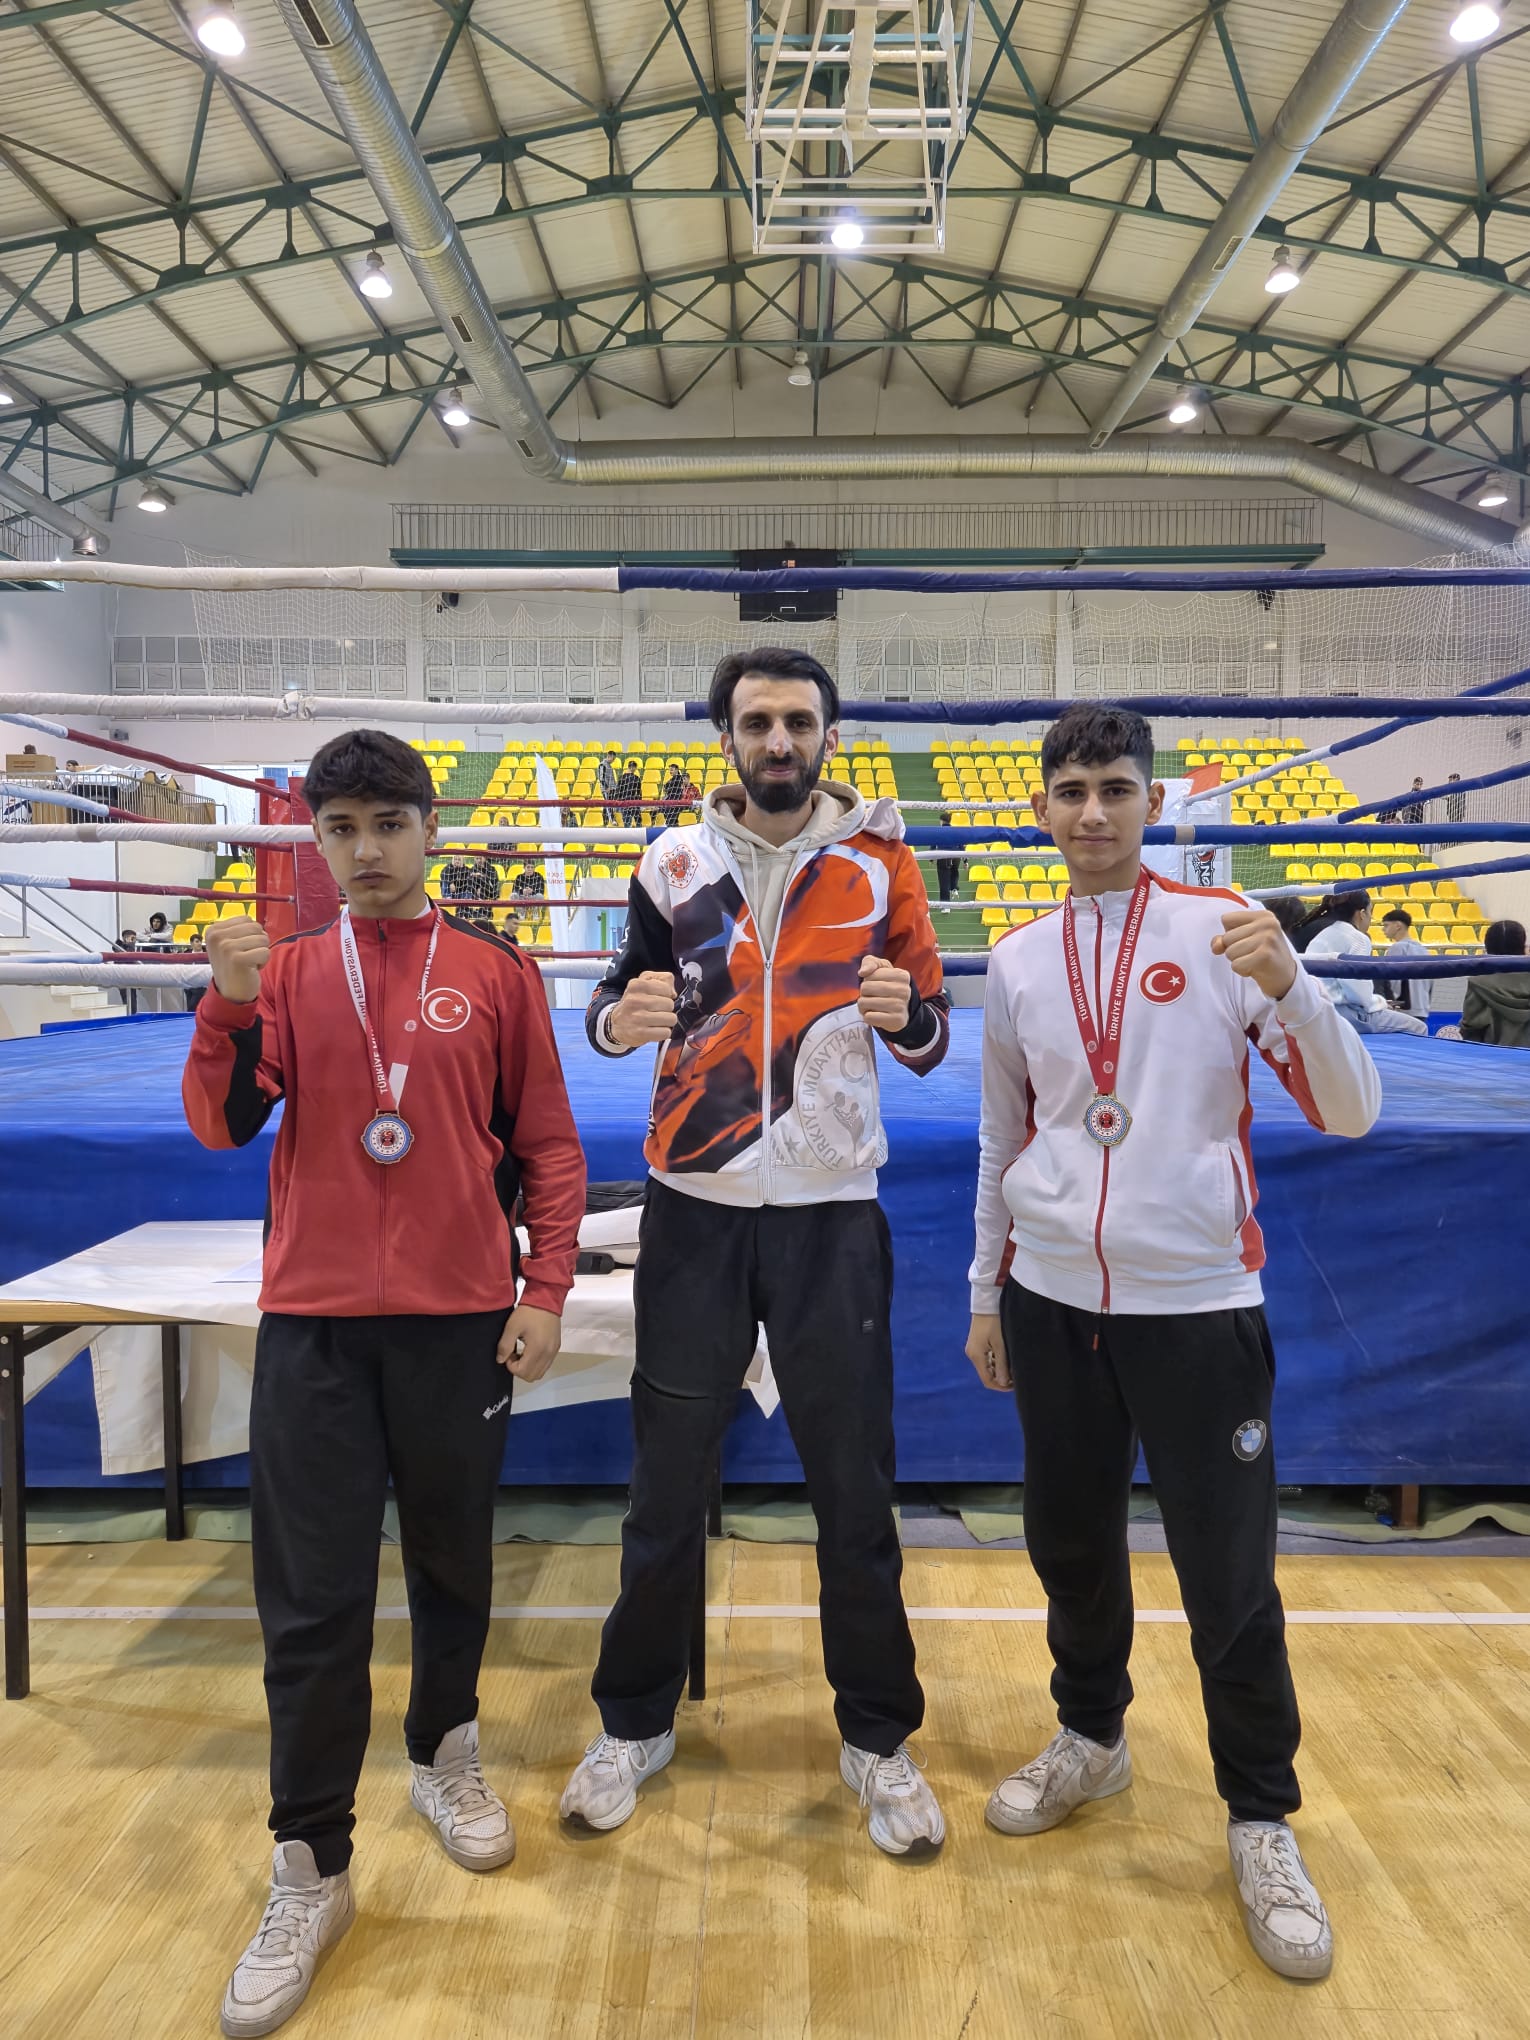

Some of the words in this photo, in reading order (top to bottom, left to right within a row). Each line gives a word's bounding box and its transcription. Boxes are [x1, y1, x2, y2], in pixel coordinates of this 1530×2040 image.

[1125, 885, 1148, 946] FEDERASYONU
[1066, 935, 1080, 981] MUAYTHAI
[1114, 948, 1132, 998] MUAYTHAI
[1073, 980, 1089, 1022] TÜRKİYE
[1108, 999, 1122, 1041] TÜRKİYE
[802, 1025, 861, 1098] MUAYTHAI
